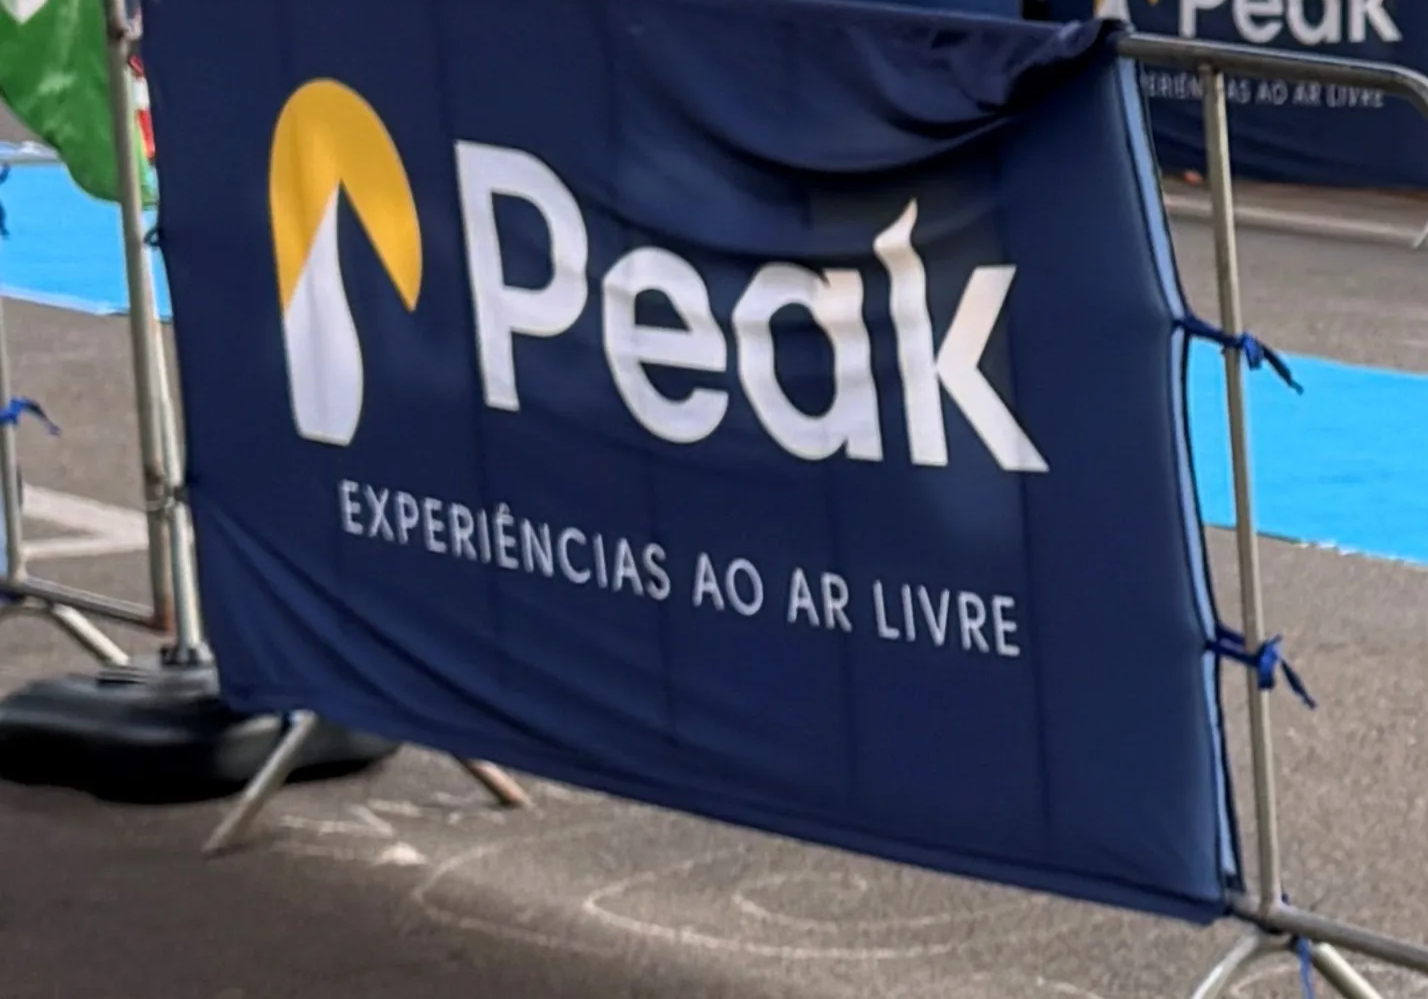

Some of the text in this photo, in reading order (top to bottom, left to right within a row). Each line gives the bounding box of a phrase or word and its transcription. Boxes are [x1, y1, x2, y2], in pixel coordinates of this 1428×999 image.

[454, 140, 1049, 473] Peak
[338, 479, 1022, 657] EXPERIÊNCIAS AO AR LIVRE
